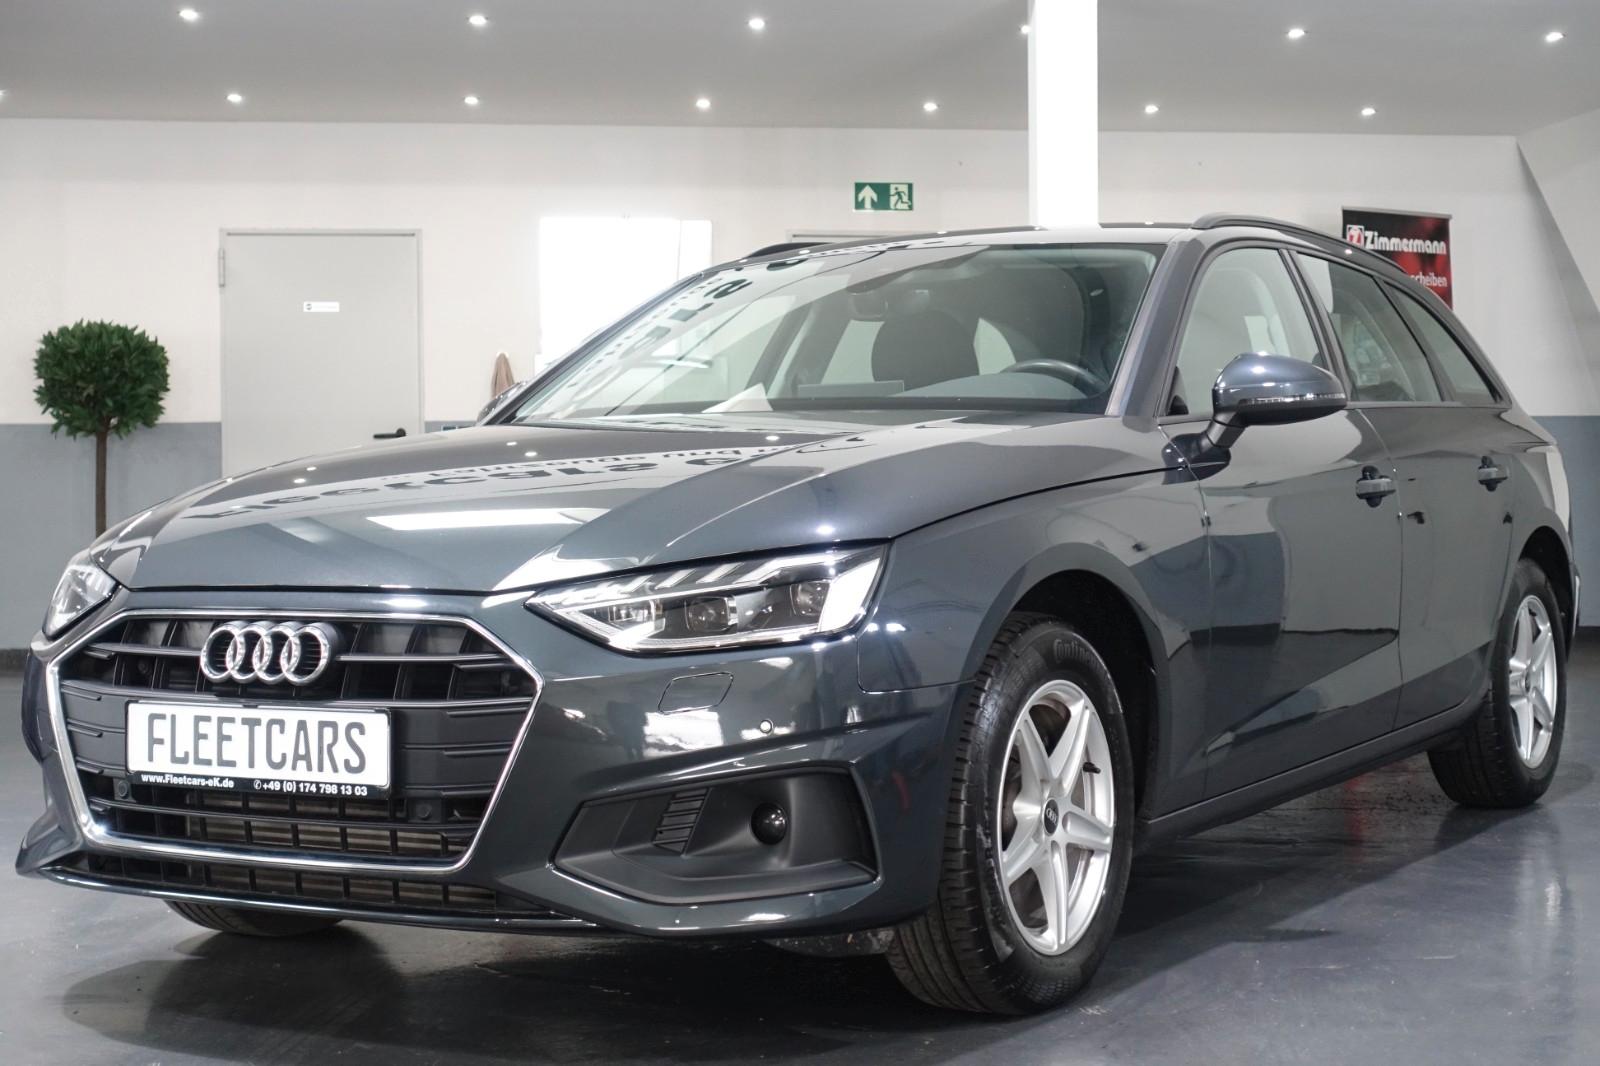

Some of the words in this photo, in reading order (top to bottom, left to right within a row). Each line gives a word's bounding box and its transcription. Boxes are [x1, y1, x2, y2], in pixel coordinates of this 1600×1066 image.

[1364, 230, 1447, 255] Zimmermann
[147, 712, 367, 775] FLEETCARS
[140, 773, 235, 789] www.Fleetcars-eK.de
[262, 780, 281, 792] +49
[282, 780, 297, 793] (0)
[299, 782, 317, 794] 174
[319, 783, 337, 795] 798
[340, 784, 352, 796] 13
[354, 785, 368, 797] 03
